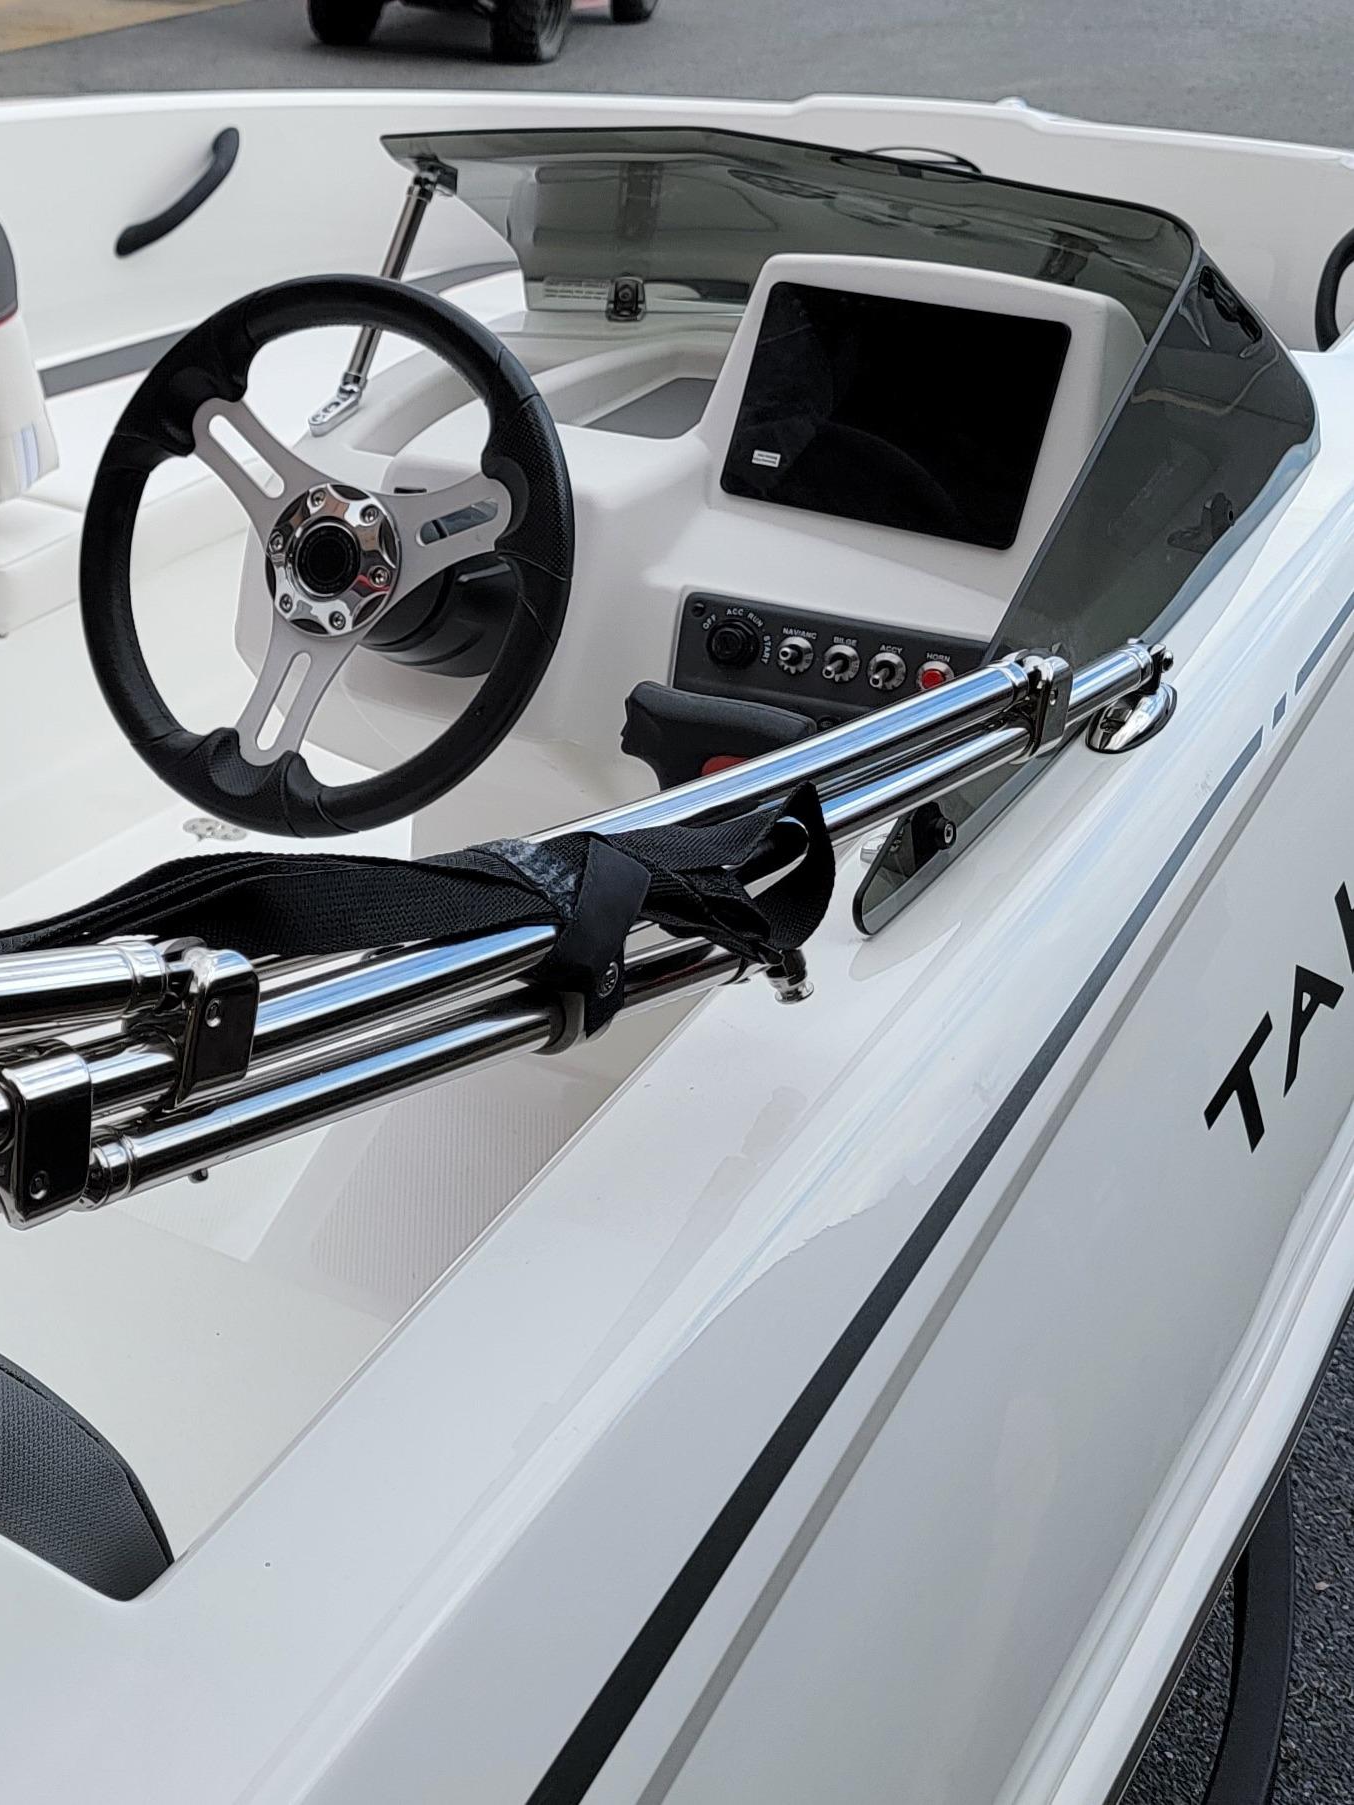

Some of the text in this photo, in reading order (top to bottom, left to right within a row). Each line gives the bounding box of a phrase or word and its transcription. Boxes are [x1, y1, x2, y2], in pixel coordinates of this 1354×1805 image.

[726, 608, 744, 616] ACC
[702, 614, 717, 630] OFF
[747, 612, 764, 628] RUN
[833, 636, 858, 647] BILGE
[760, 635, 771, 664] START
[879, 644, 903, 655] ACCY
[926, 652, 951, 663] HORN
